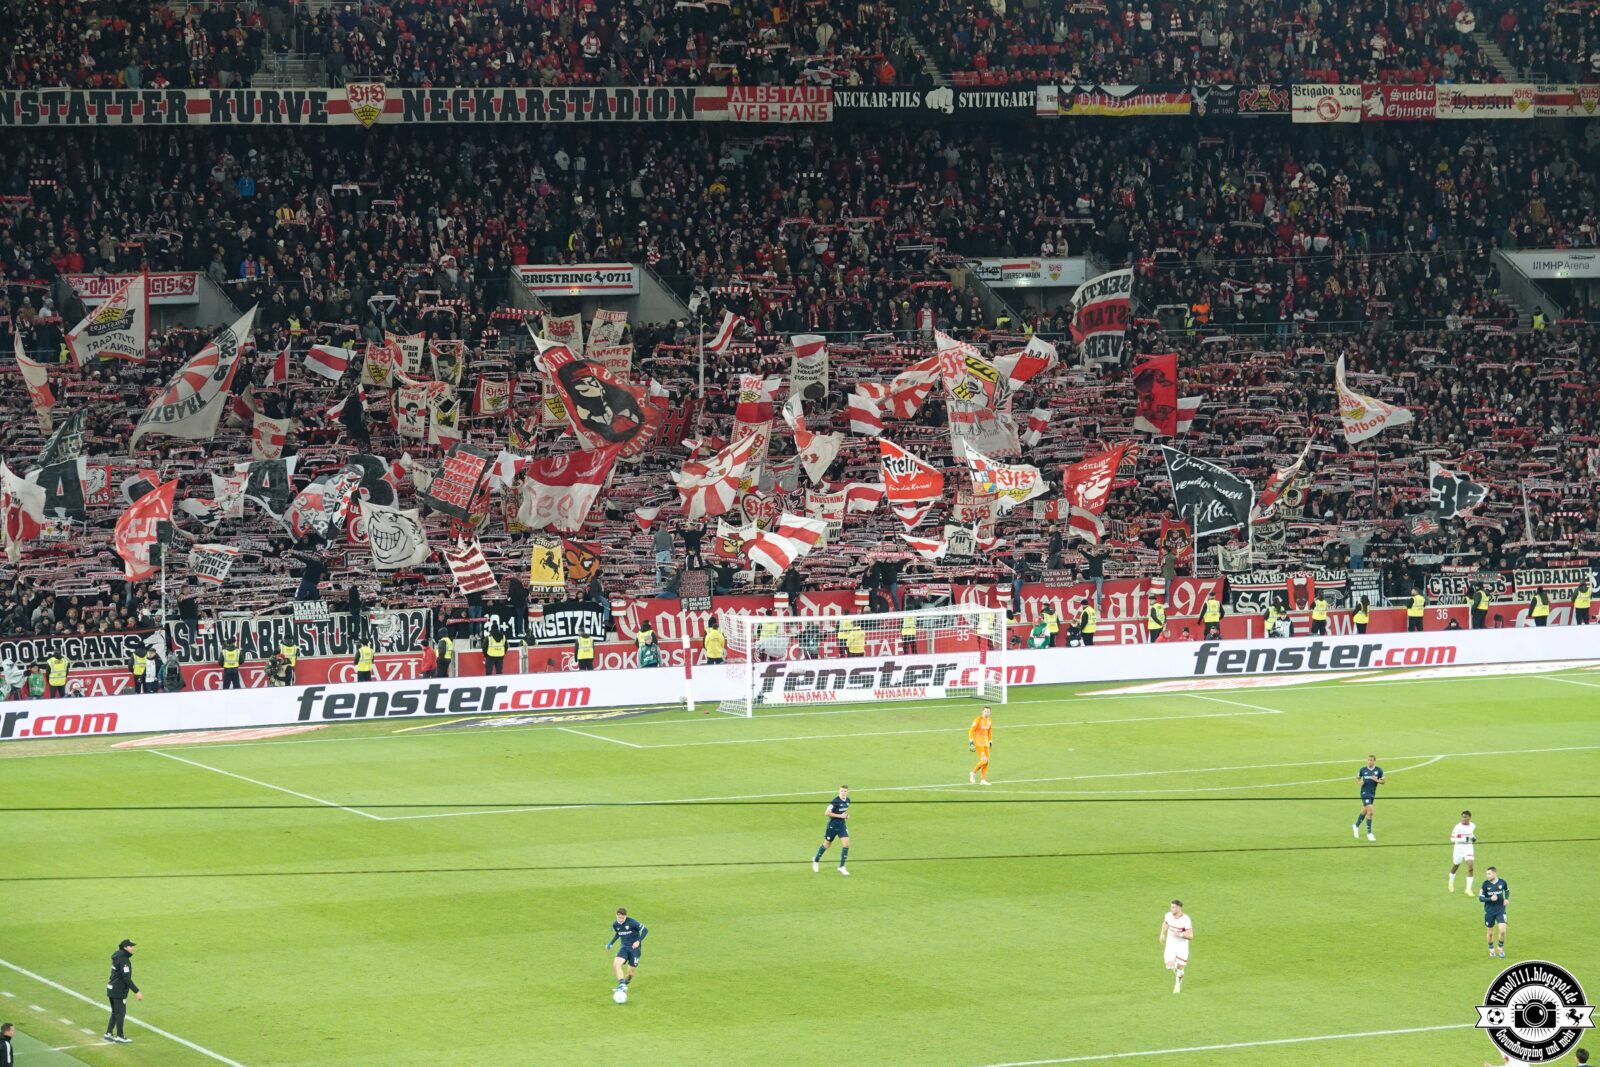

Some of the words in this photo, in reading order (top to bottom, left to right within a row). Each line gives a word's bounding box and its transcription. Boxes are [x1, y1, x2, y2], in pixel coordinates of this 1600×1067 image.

[731, 86, 833, 103] ALBSTADT
[834, 91, 921, 108] NECKAR-FILS
[959, 90, 1037, 108] STUTTGART
[1292, 86, 1335, 98] Brigada
[1389, 88, 1435, 101] Suebia
[1452, 89, 1512, 111] Hessen
[209, 89, 329, 124] KURVE
[402, 88, 696, 122] NECKARSTADION
[733, 104, 829, 121] VFB-FANS
[1386, 104, 1436, 119] Ehingen
[1542, 261, 1564, 270] MHP
[1563, 261, 1590, 270] Arena
[522, 273, 593, 284] BRUSTRING
[606, 272, 632, 282] 0711
[1515, 568, 1590, 586] SÜDBANDE
[293, 601, 328, 610] ULTRAS
[1436, 608, 1449, 620] 36
[956, 628, 970, 642] 35
[1194, 641, 1457, 677] fenster.com
[759, 660, 1036, 693] fenster.com
[783, 689, 837, 703] WINAMAX
[874, 686, 927, 699] WINAMAX
[298, 684, 591, 722] fenster.com
